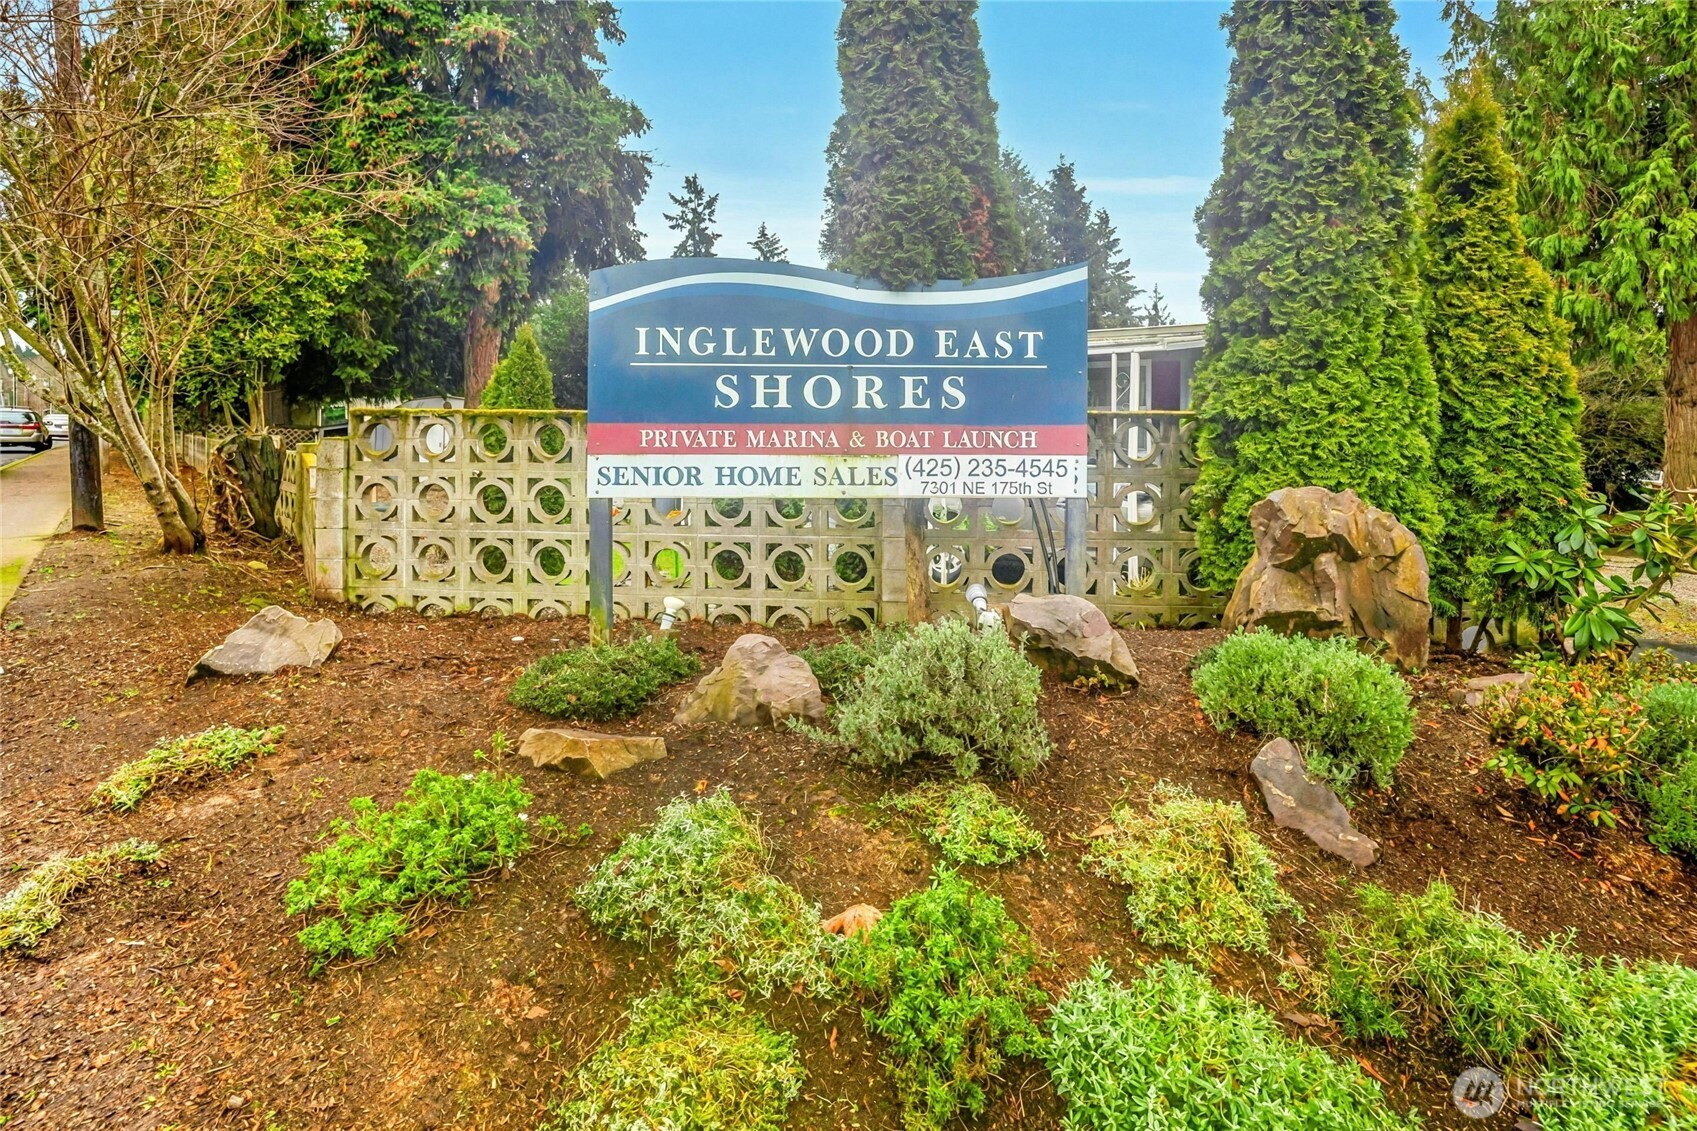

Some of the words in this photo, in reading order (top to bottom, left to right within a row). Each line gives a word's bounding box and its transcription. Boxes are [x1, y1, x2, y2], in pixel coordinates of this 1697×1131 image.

[634, 326, 915, 358] INGLEWOOD
[934, 328, 1044, 359] EAST
[714, 374, 967, 410] SHORES
[639, 429, 737, 448] PRIVATE
[745, 429, 841, 448] MARINA
[849, 430, 866, 448] &
[875, 430, 935, 448] BOAT
[942, 430, 1038, 449] LAUNCH
[597, 465, 704, 487] SENIOR
[713, 465, 802, 487] HOME
[813, 466, 899, 487] SALES
[905, 456, 961, 480] (425)
[967, 458, 1068, 478] 235-4545
[920, 481, 957, 495] 7301
[962, 481, 985, 495] NE
[991, 481, 1032, 495] 175th
[1036, 481, 1053, 495] St
